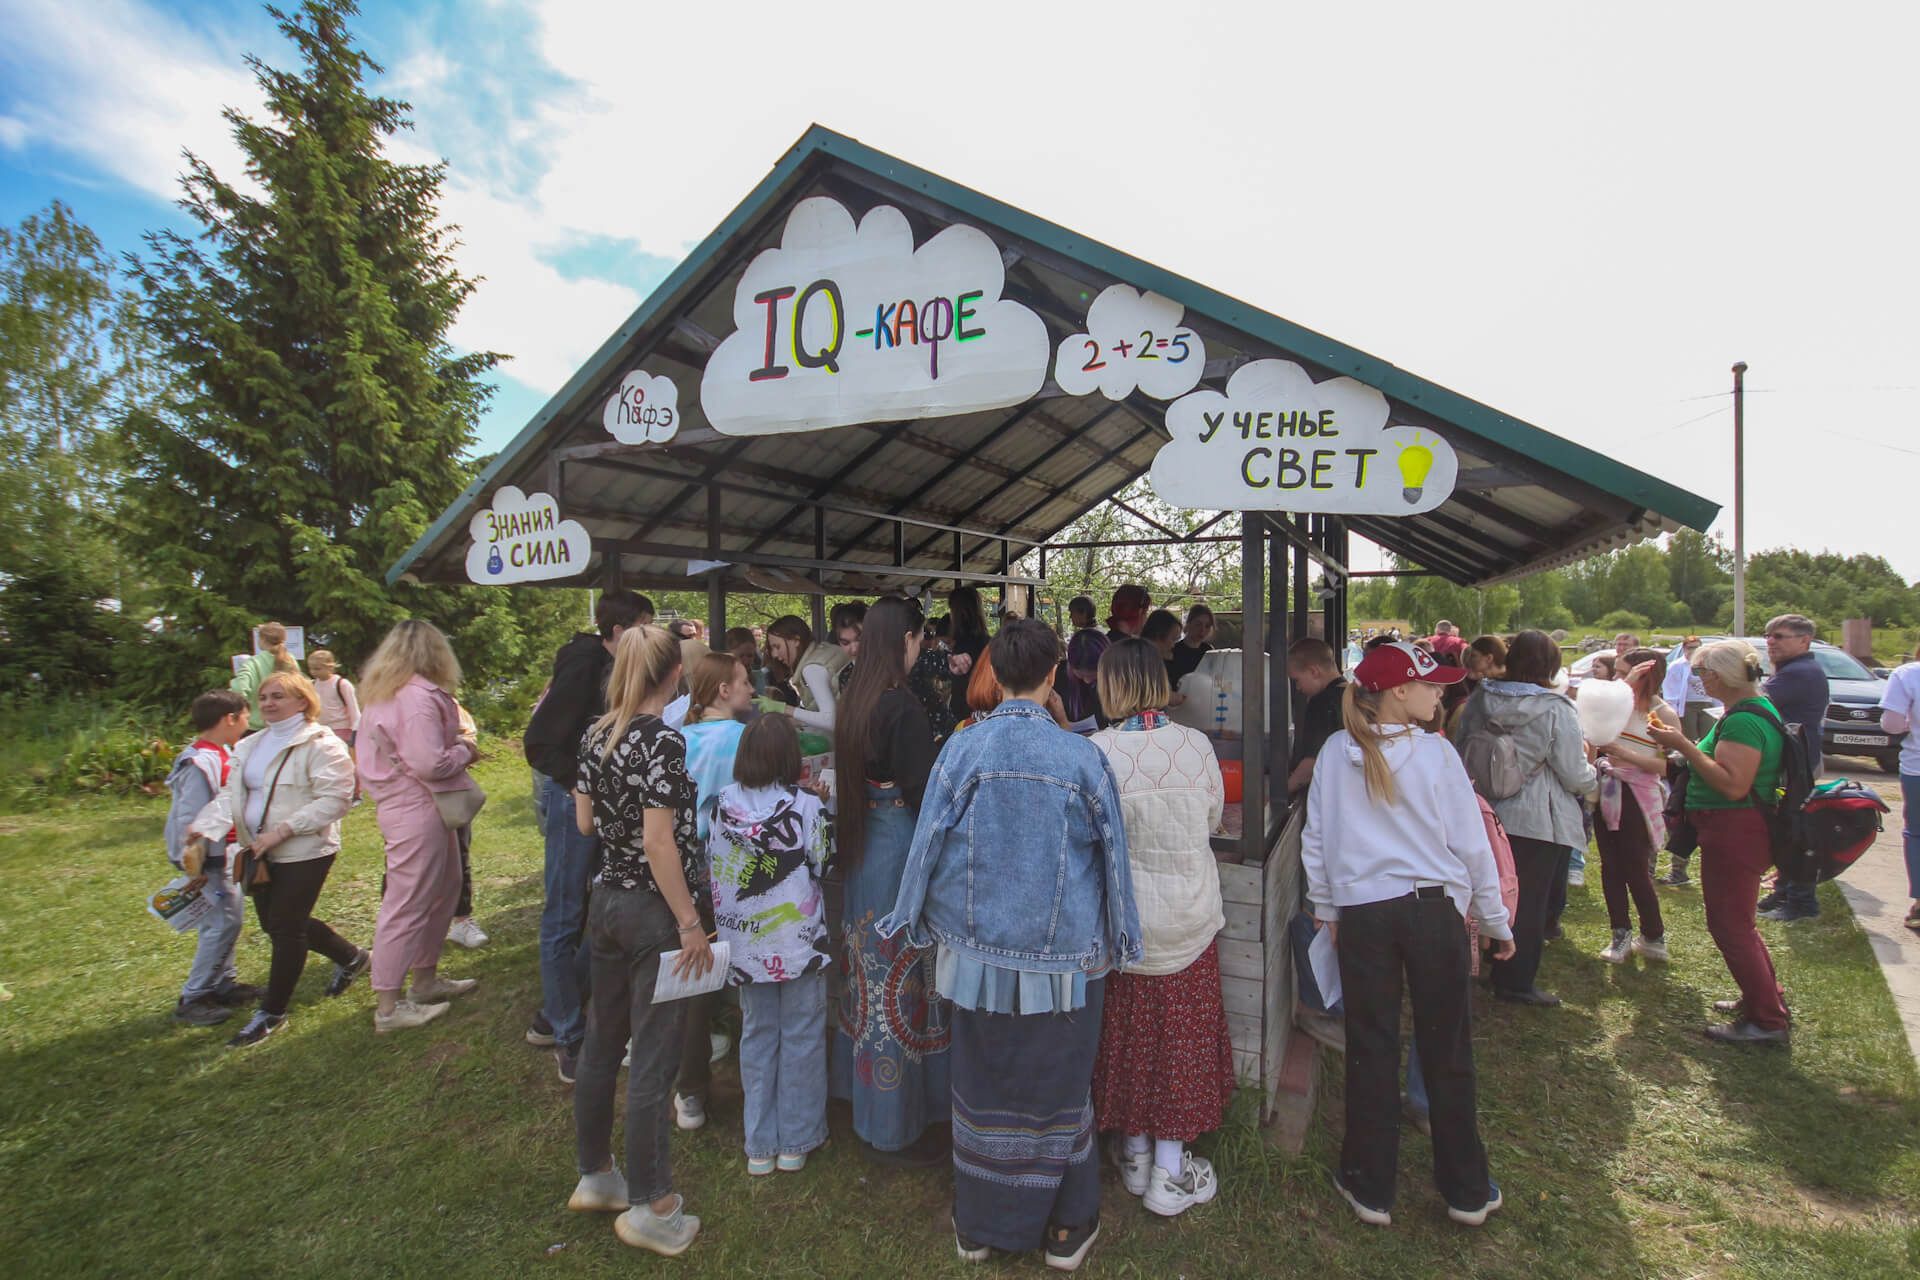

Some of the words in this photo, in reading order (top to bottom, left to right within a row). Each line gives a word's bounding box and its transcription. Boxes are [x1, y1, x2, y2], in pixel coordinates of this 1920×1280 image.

[1241, 447, 1377, 490] СВЕТ
[485, 505, 554, 543] ЗНАНИЯ
[509, 536, 570, 567] СИЛА
